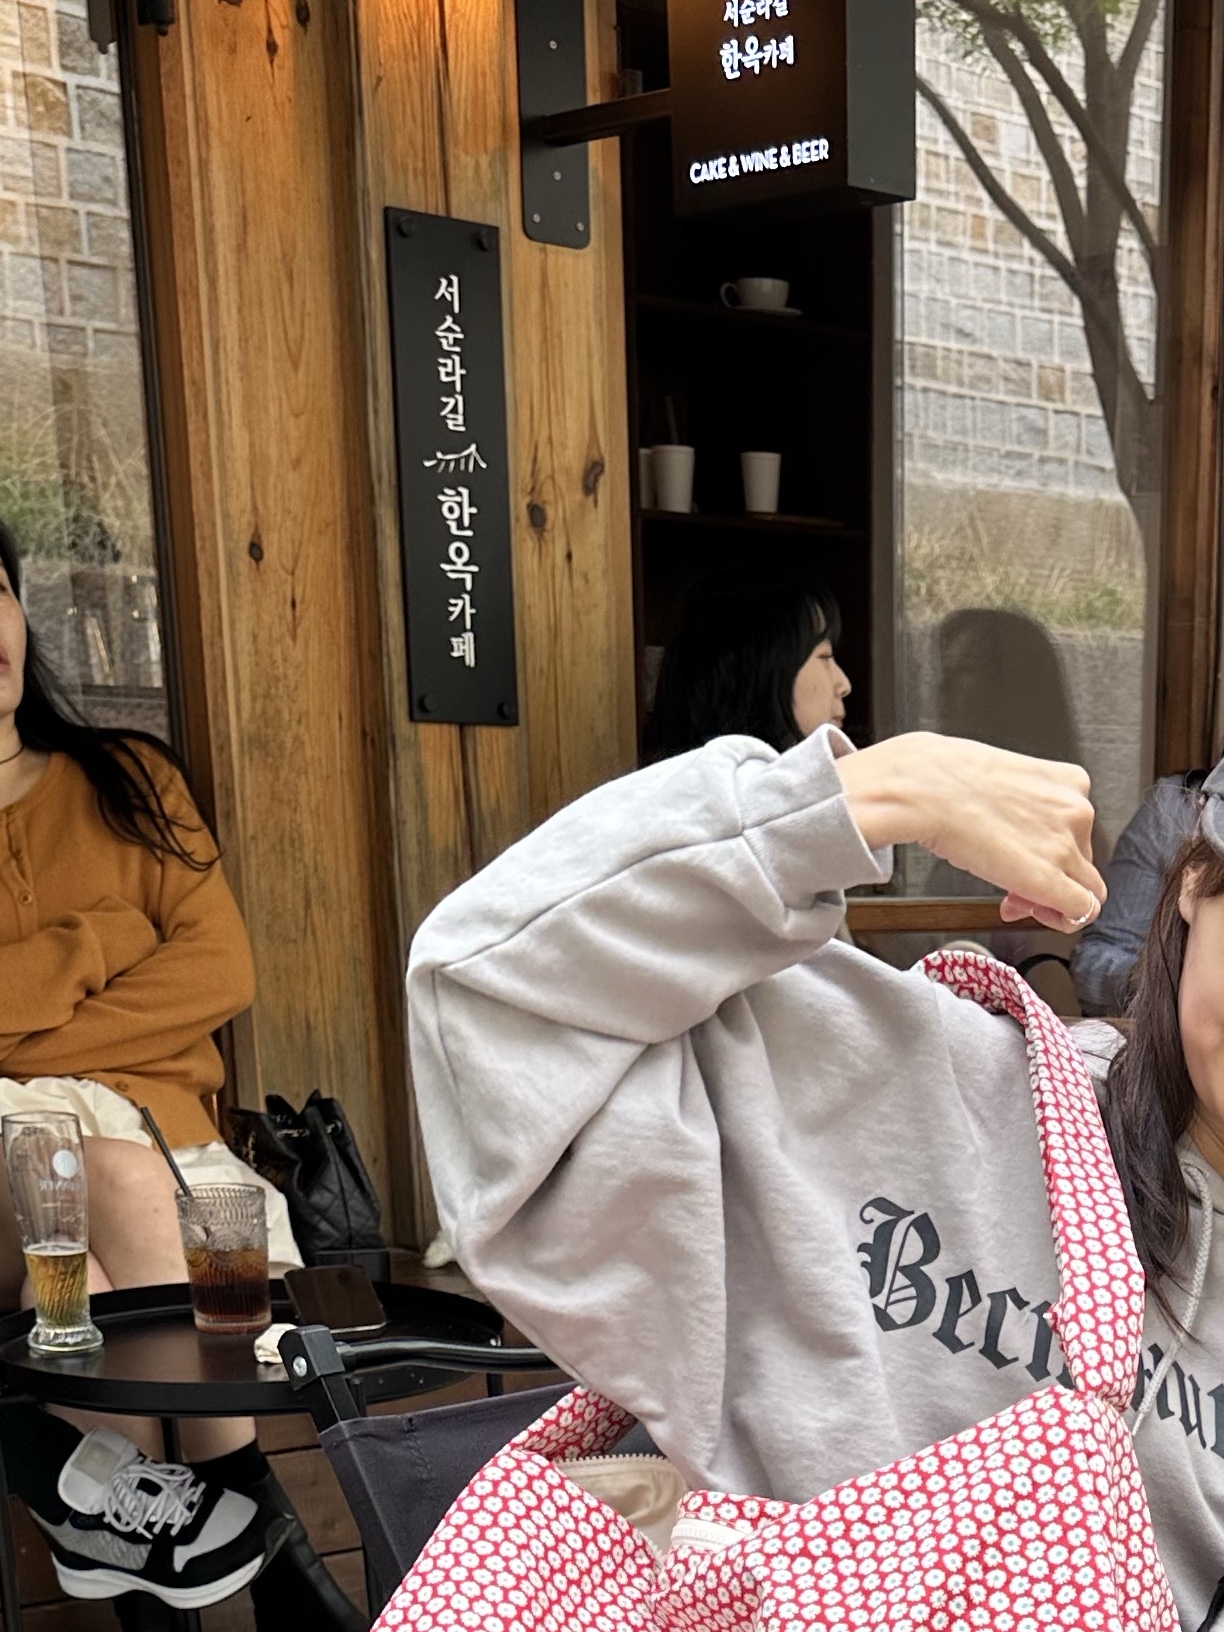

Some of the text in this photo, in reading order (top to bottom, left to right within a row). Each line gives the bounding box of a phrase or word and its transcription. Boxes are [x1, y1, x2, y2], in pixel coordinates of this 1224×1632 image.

[719, 34, 795, 80] 한옥카페
[690, 138, 829, 184] CAKE & WINE & BEER
[434, 274, 479, 668] 서순라길 한옥카페
